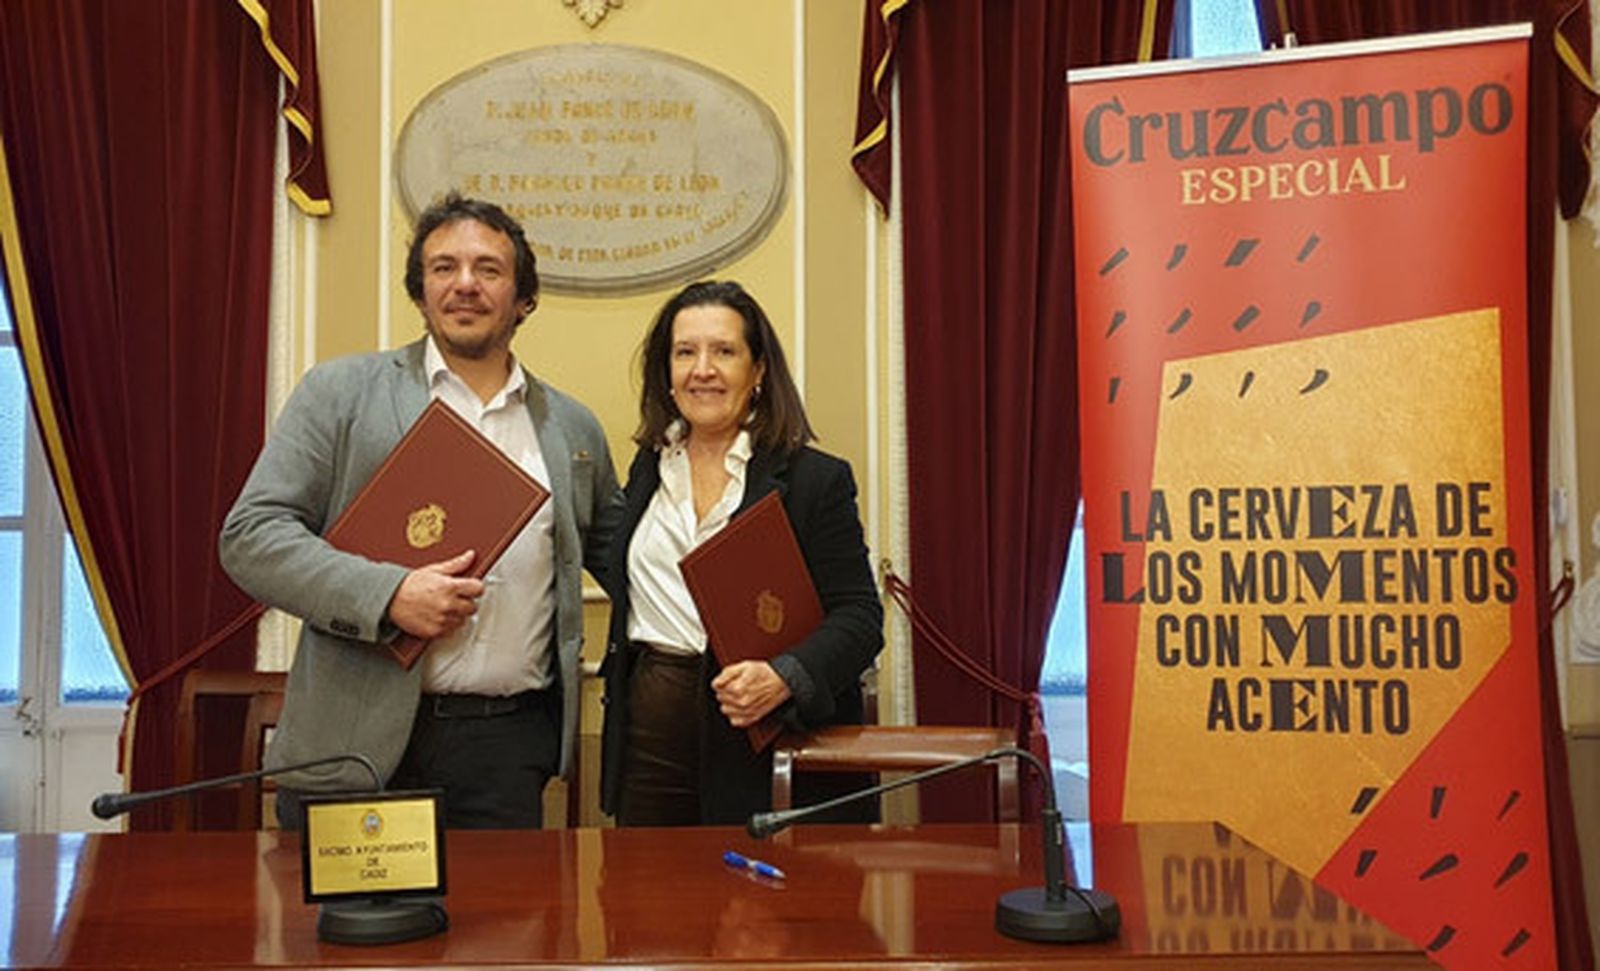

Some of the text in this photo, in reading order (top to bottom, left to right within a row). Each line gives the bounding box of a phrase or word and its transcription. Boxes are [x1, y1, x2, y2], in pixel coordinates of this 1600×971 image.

[1082, 82, 1513, 167] Cruzcampo
[1181, 154, 1406, 205] ESPECIAL
[1121, 482, 1492, 543] LA CERVEZA DE
[1101, 547, 1519, 604] LOS MOMENTOS
[1156, 613, 1462, 669] CON MUCHO
[1207, 677, 1410, 735] ACENTO
